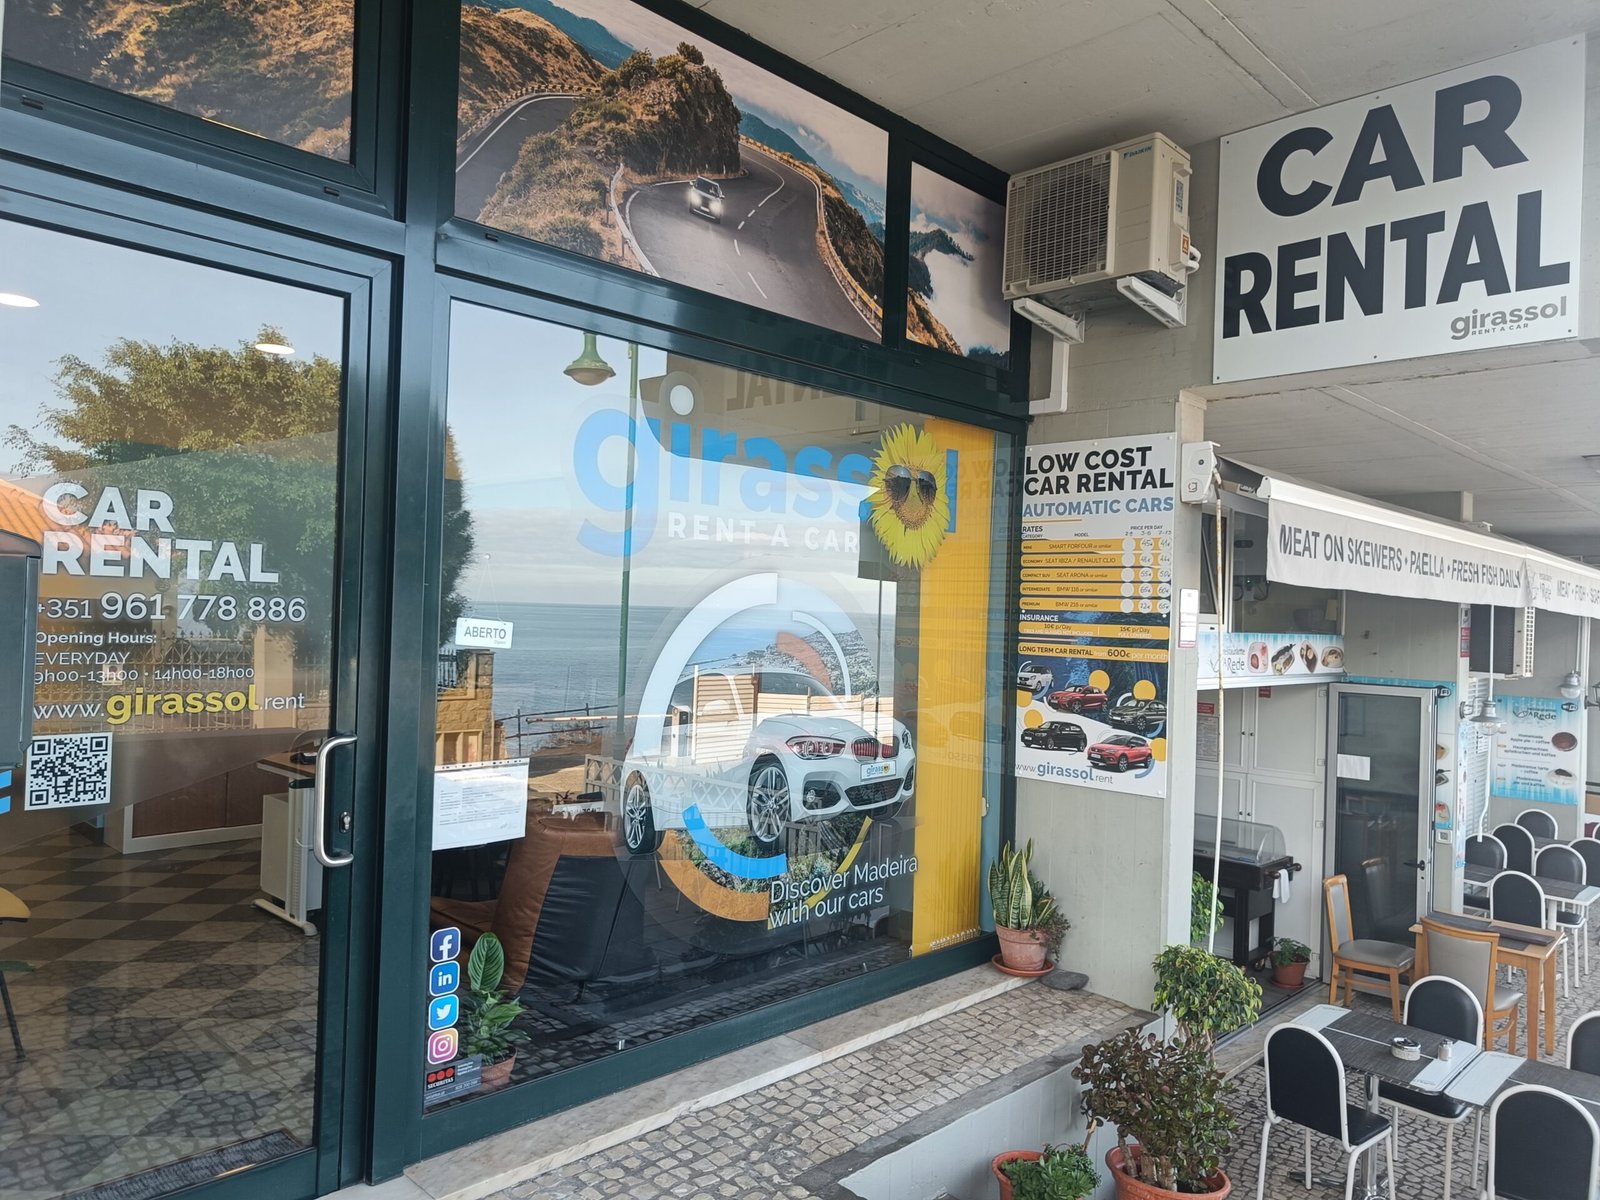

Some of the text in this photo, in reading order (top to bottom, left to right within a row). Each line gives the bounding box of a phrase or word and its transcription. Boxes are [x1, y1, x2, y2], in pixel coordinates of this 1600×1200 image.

[1257, 75, 1529, 217] CAR
[1222, 189, 1570, 339] RENTAL
[1450, 296, 1567, 340] girassol
[1025, 446, 1152, 475] LOW COST
[1024, 468, 1174, 496] CAR RENTAL
[42, 482, 174, 533] CAR
[1022, 496, 1174, 518] AUTOMATIC CARS
[668, 512, 858, 554] RENT A CAR
[42, 532, 280, 584] RENTAL
[1279, 524, 1521, 589] MEAT ON SKEWERS PAELLA FRESH FISH DAILY
[1557, 580, 1571, 598] MEAT
[38, 592, 306, 622] +351 961 778 886
[1020, 614, 1058, 622] INSURANCE
[36, 632, 157, 646] Opening Hours:
[464, 626, 506, 639] ABERTO
[36, 652, 130, 665] EVERYDAY
[1107, 648, 1130, 658] 600€
[1145, 652, 1168, 660] month
[34, 667, 254, 684] 9h00-13h00 14h00-18h00
[1534, 712, 1556, 720] Rede
[771, 854, 918, 904] Discover Madeira
[770, 887, 883, 929] with our cars
